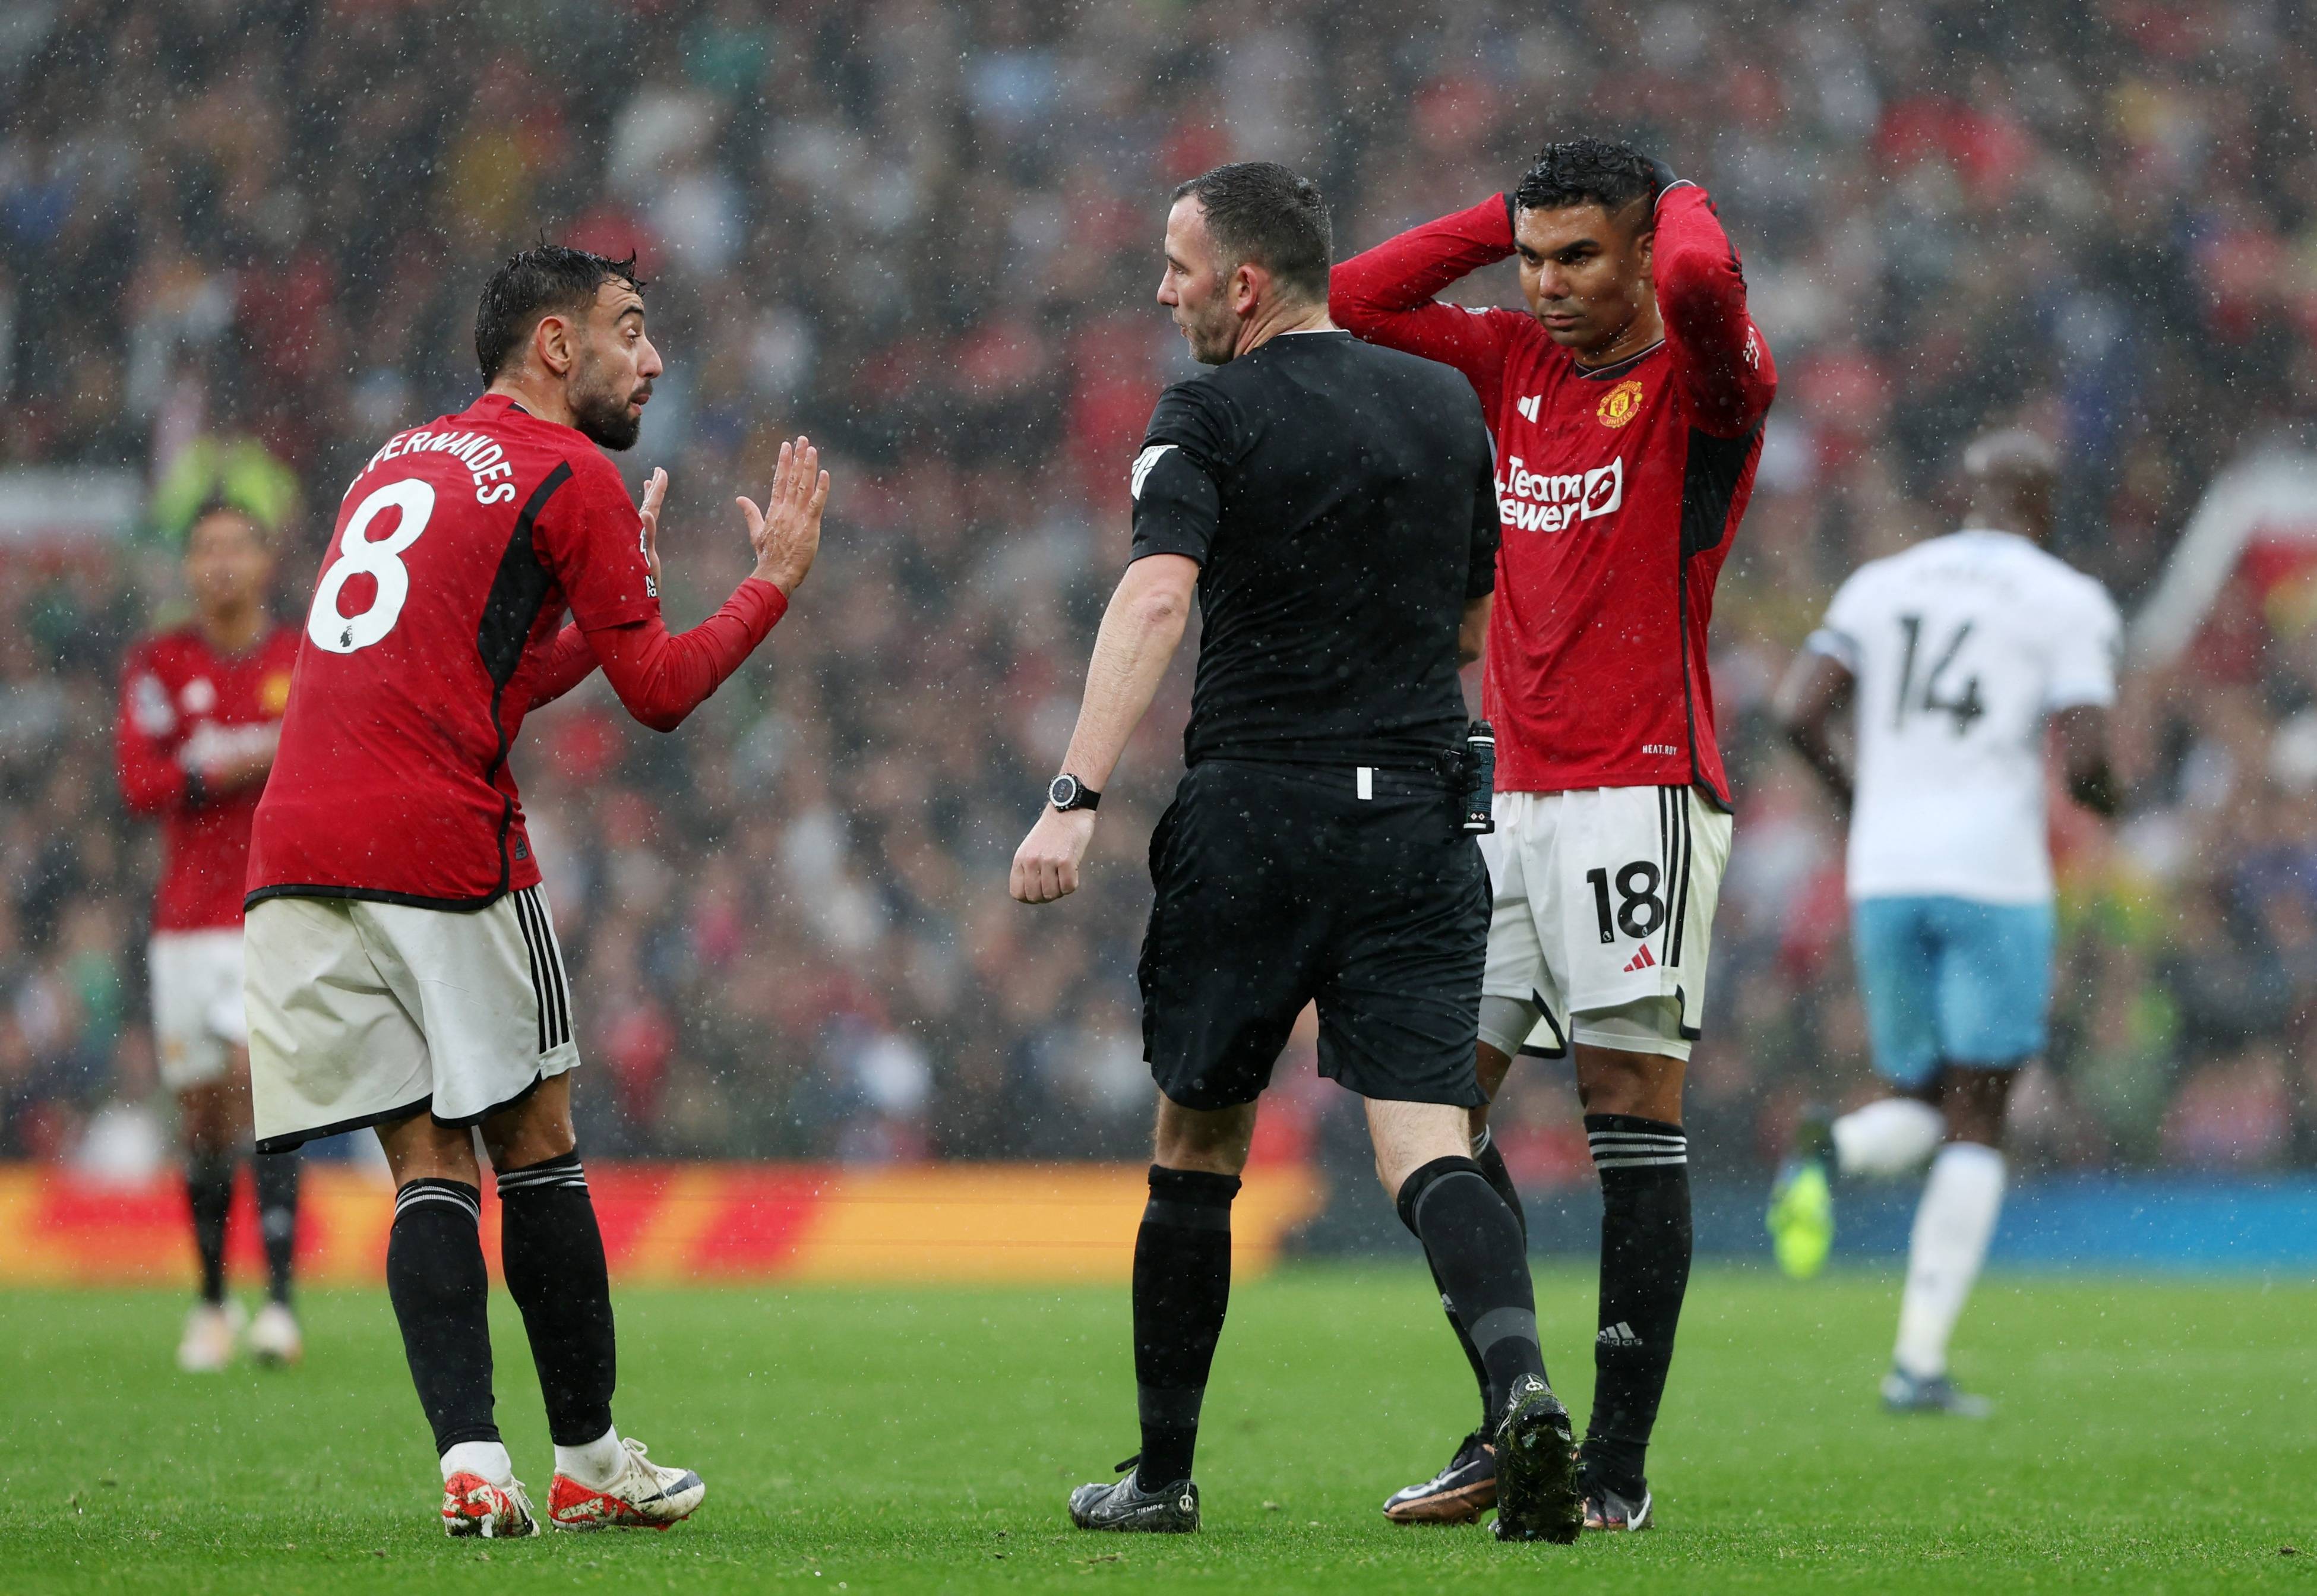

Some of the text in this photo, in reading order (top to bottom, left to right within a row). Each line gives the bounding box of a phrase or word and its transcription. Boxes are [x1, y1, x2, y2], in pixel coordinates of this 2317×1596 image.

[1606, 411, 1633, 425] UNITED
[367, 431, 516, 505] FERNANDES
[1506, 455, 1583, 502] Team
[1495, 481, 1579, 532] ewer
[308, 478, 436, 654] 8
[1891, 614, 1986, 737] 14
[1586, 860, 1665, 944] 18
[1597, 1335, 1643, 1347] adidas
[1136, 1503, 1163, 1515] TIEMPO
